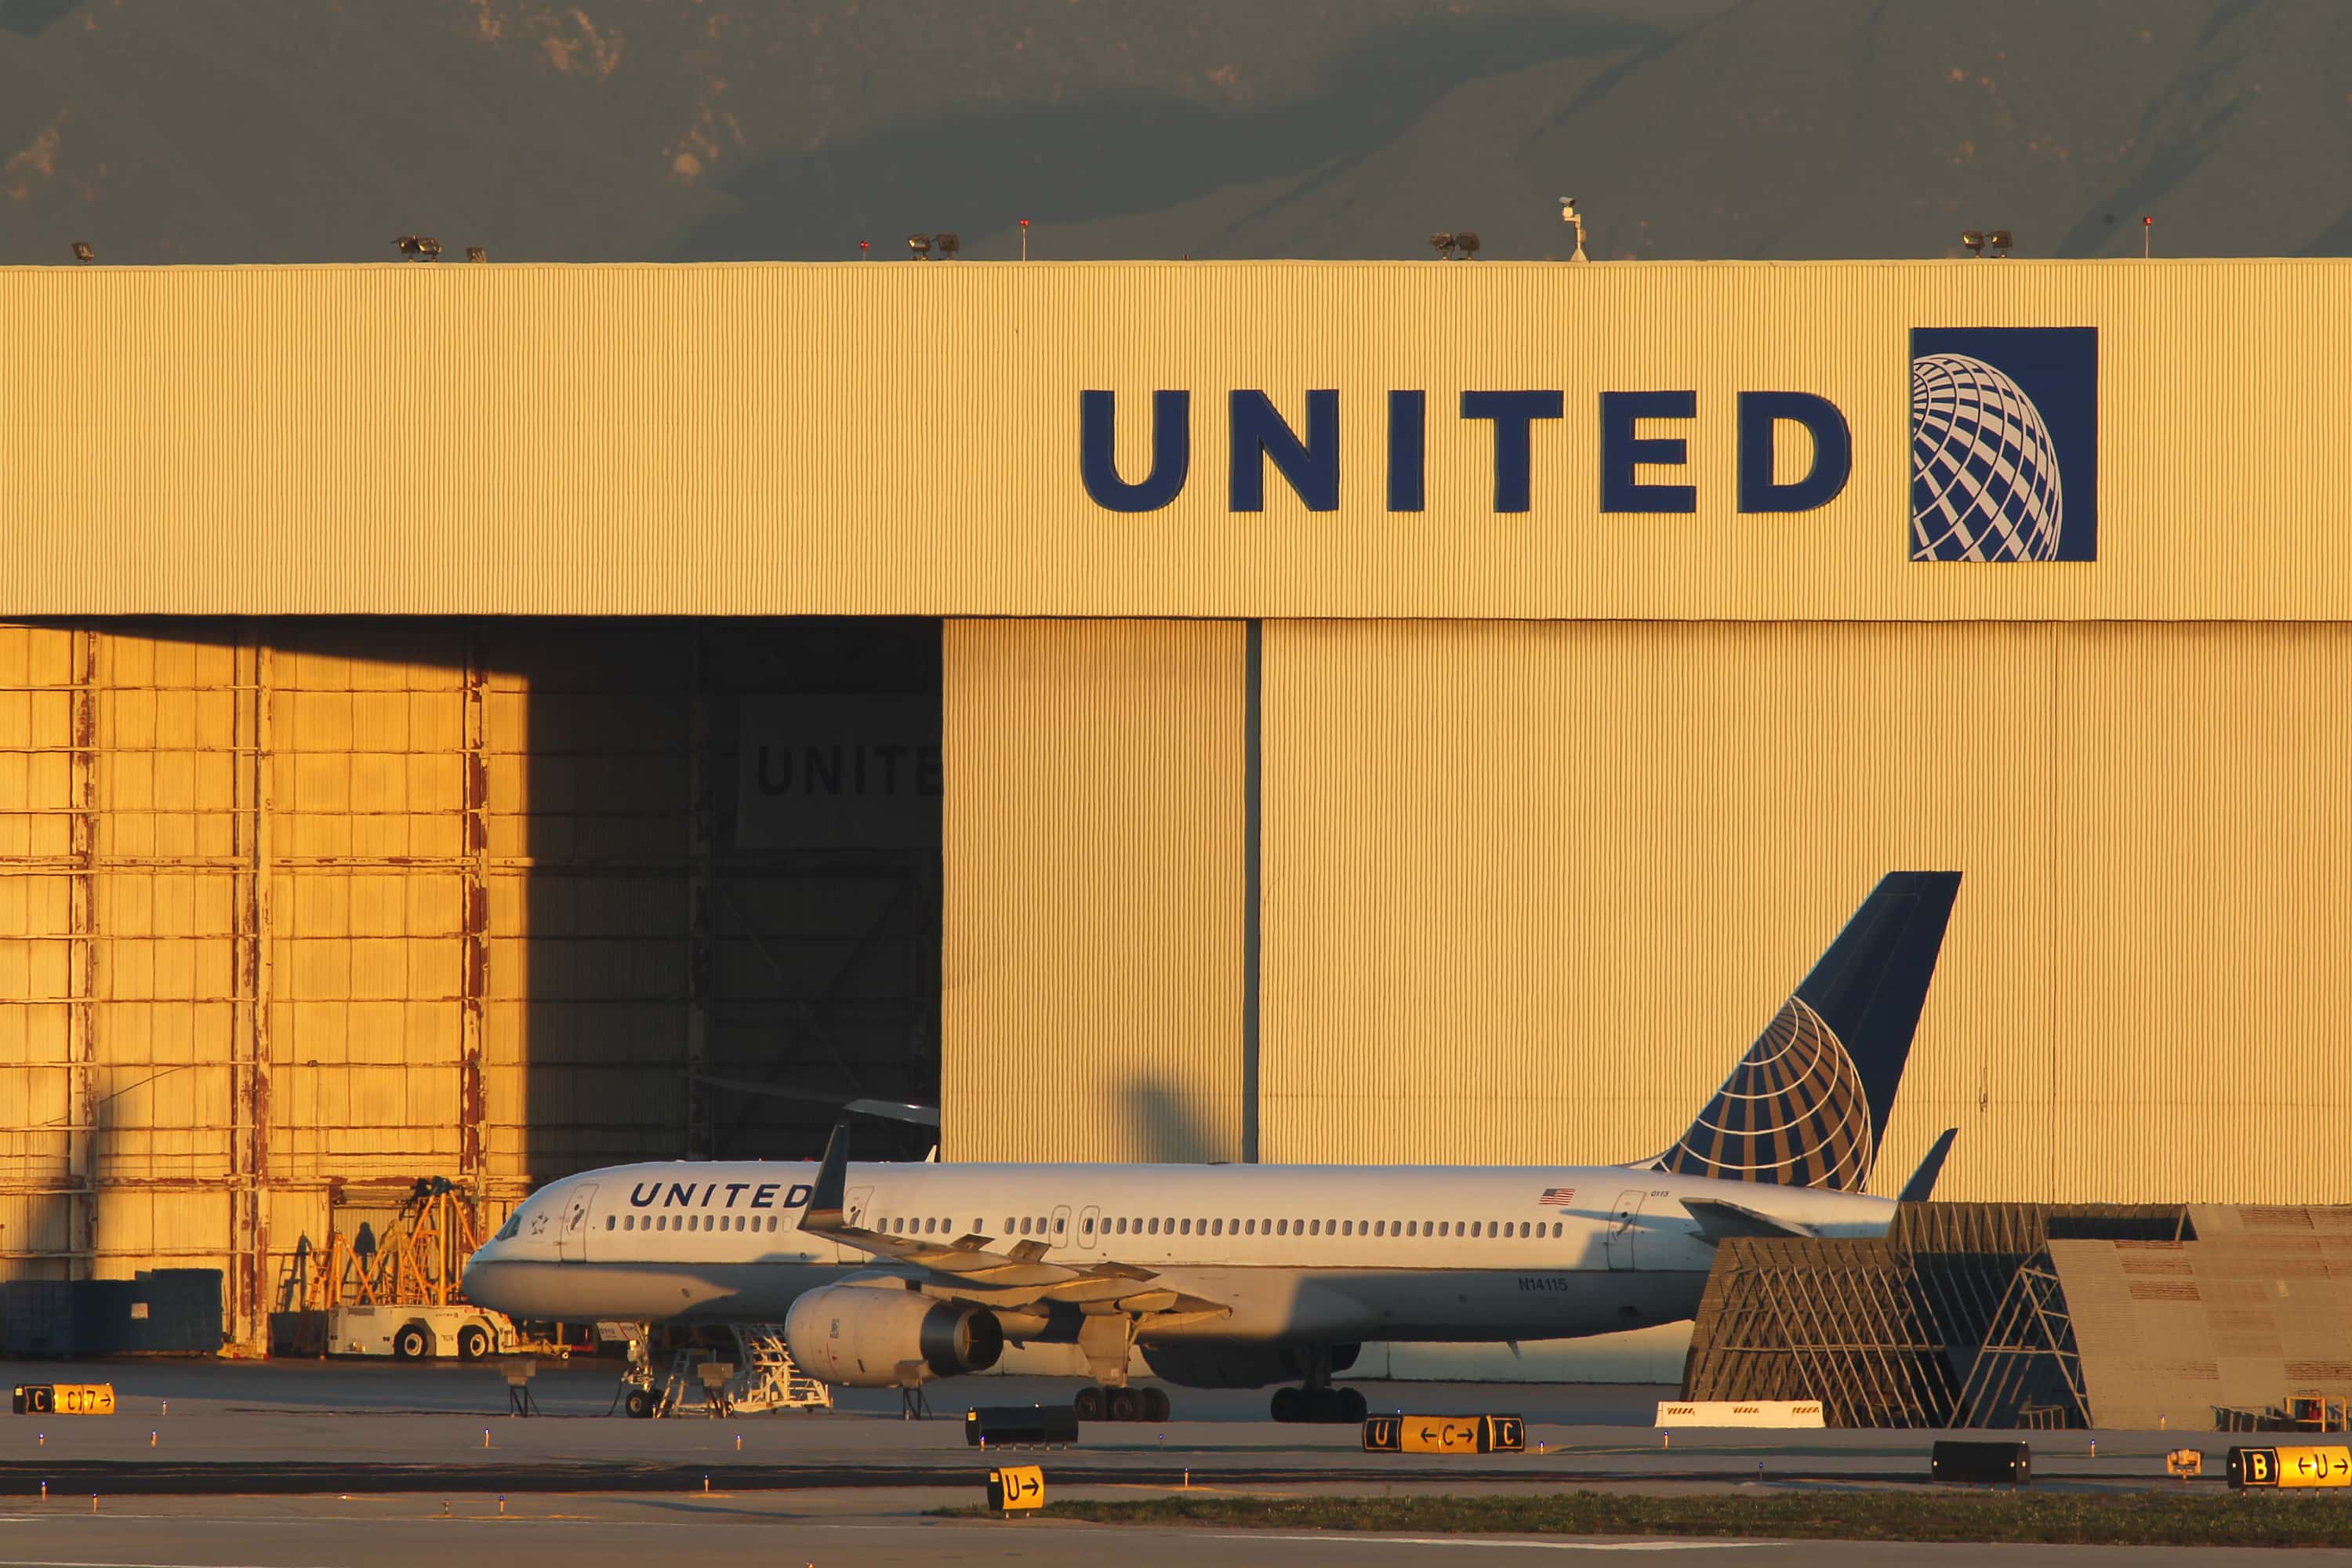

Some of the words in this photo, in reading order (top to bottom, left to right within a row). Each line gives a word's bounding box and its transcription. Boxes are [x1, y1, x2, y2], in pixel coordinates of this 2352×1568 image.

[1081, 389, 1852, 514] UNITED
[630, 1182, 814, 1208] UNITED
[1518, 1276, 1569, 1292] N14115
[34, 1390, 45, 1410] C
[1375, 1421, 1389, 1446] U
[1443, 1424, 1455, 1446] C
[1504, 1422, 1514, 1445] C
[2252, 1454, 2268, 1480] B
[2315, 1454, 2328, 1479] U
[1005, 1474, 1020, 1501] U
